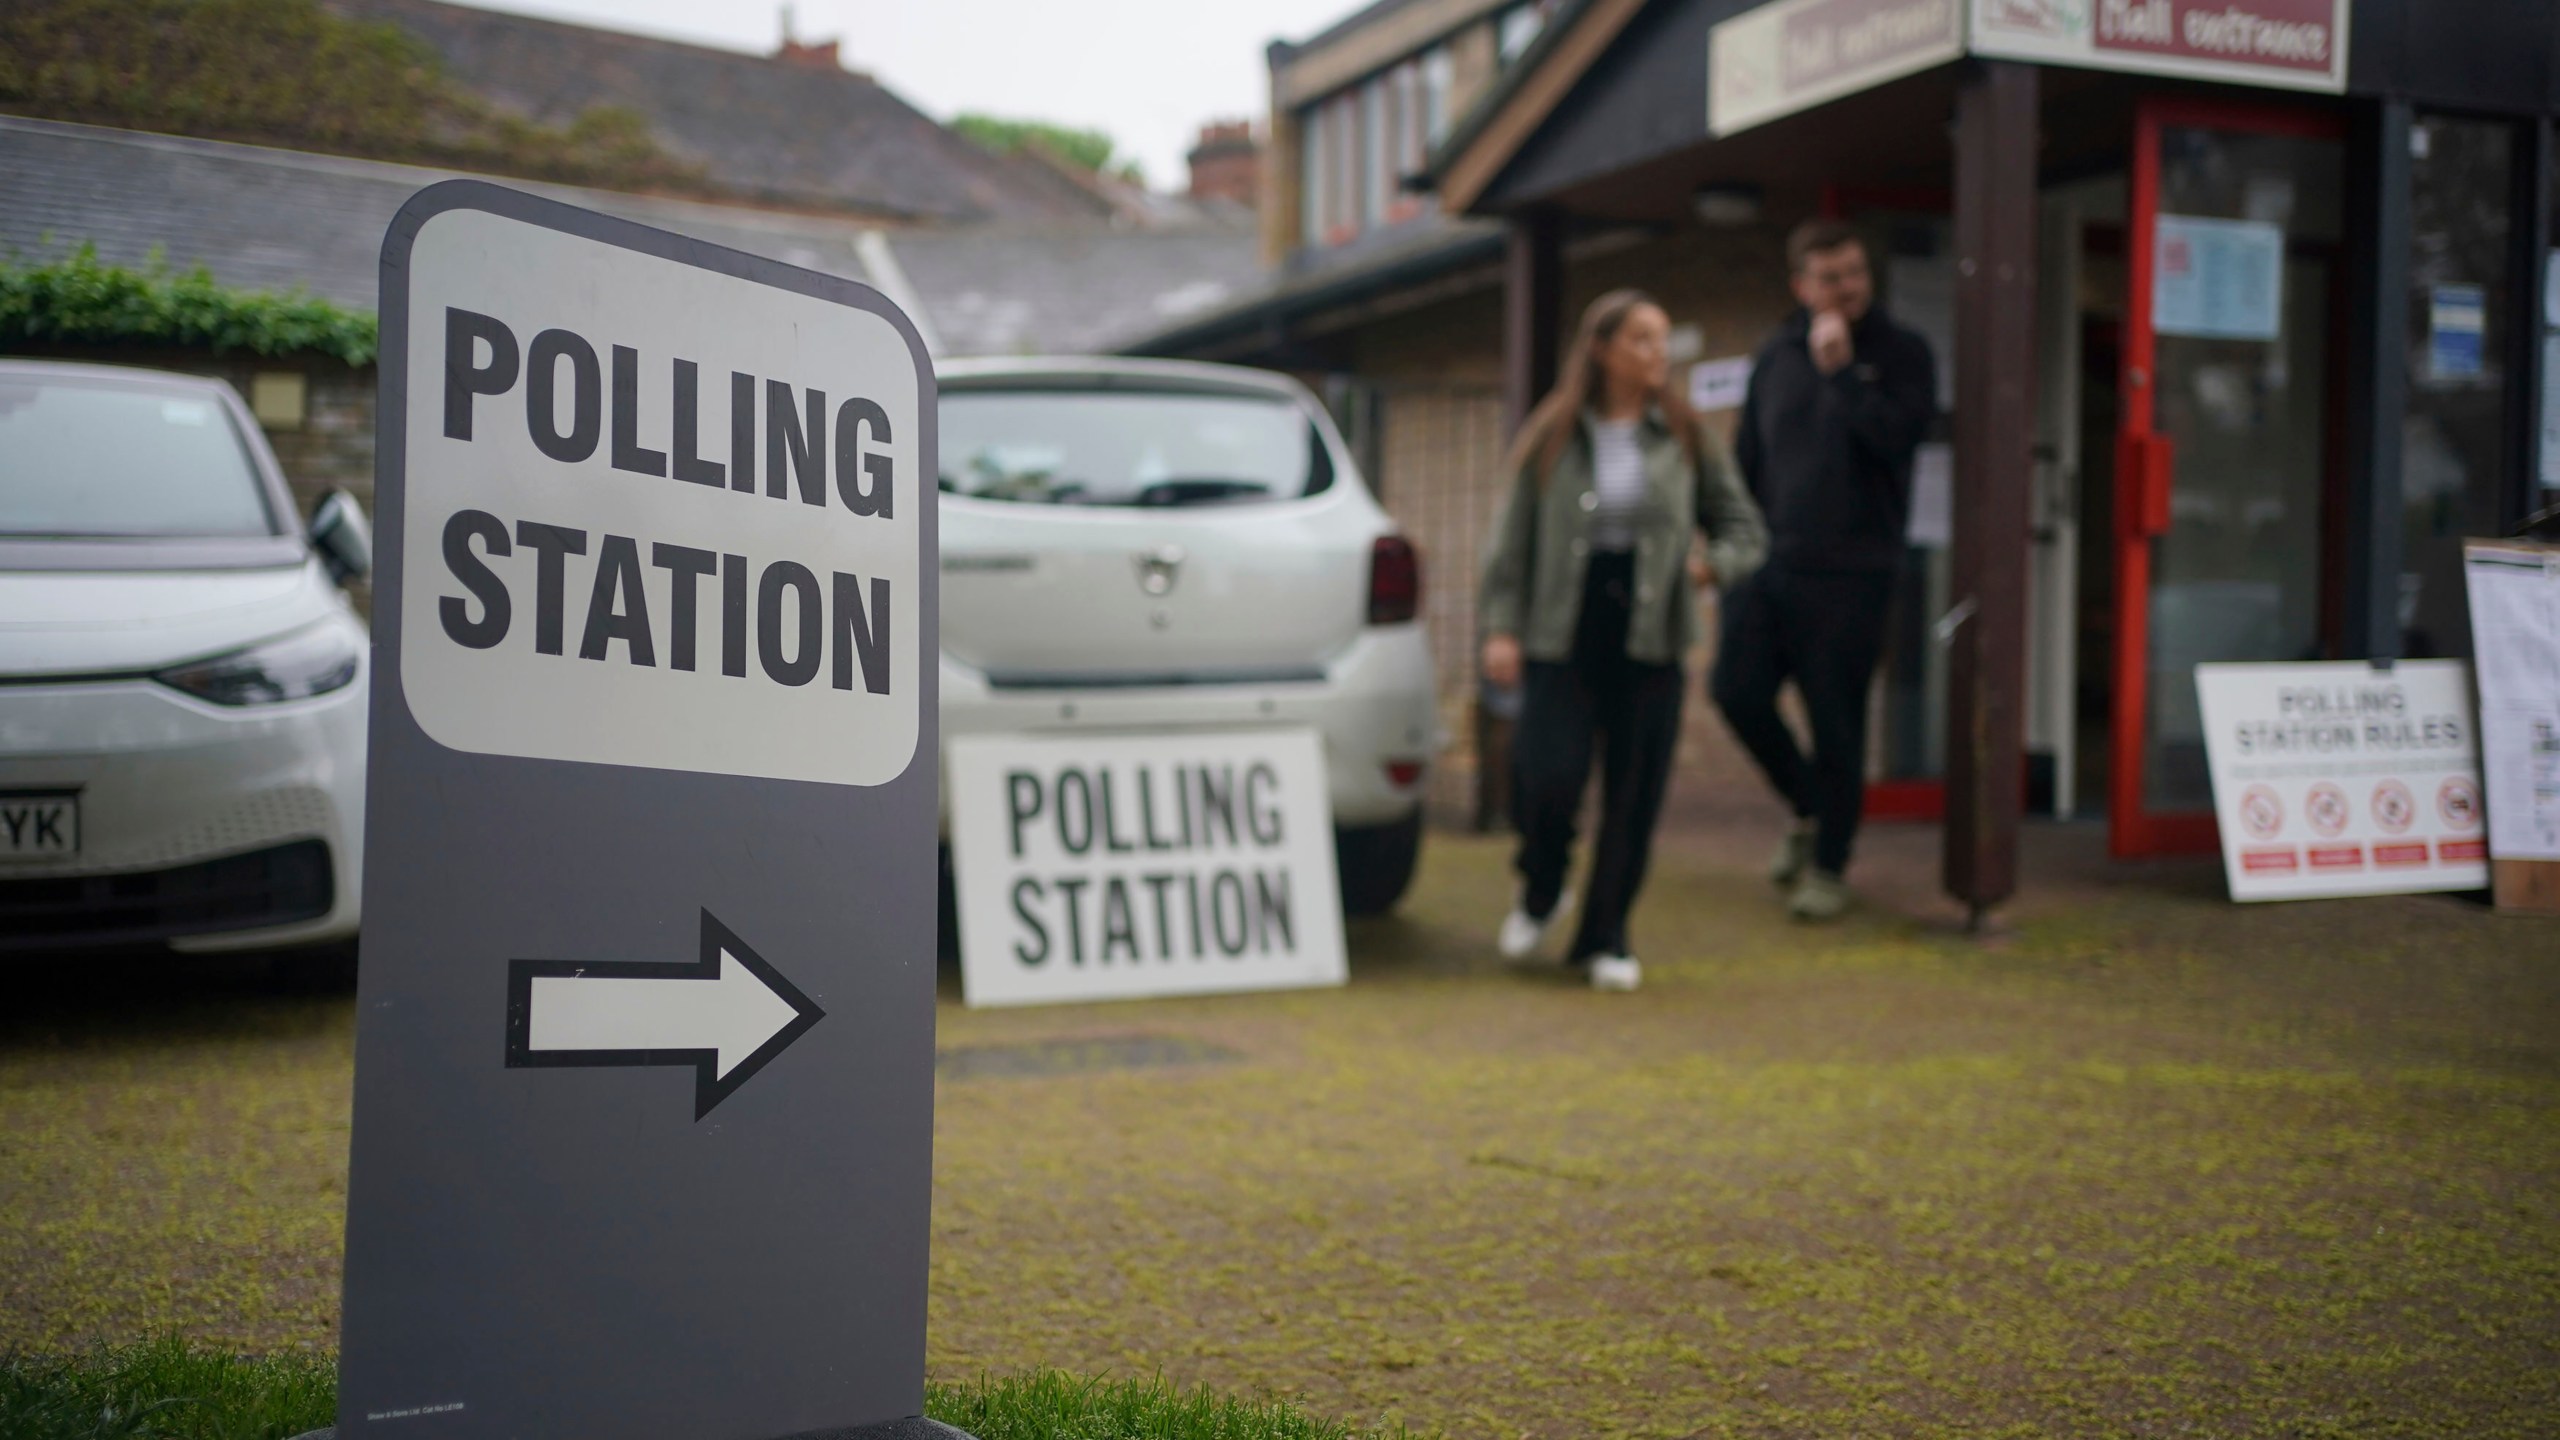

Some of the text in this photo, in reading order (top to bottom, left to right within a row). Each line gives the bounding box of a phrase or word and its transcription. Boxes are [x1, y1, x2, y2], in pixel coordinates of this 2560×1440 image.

[444, 306, 893, 519] POLLING
[439, 510, 890, 695] STATION
[2236, 716, 2462, 753] STATION RULES
[2278, 685, 2406, 716] POLLING
[1007, 762, 1282, 857] POLLING
[1012, 867, 1294, 966] STATION
